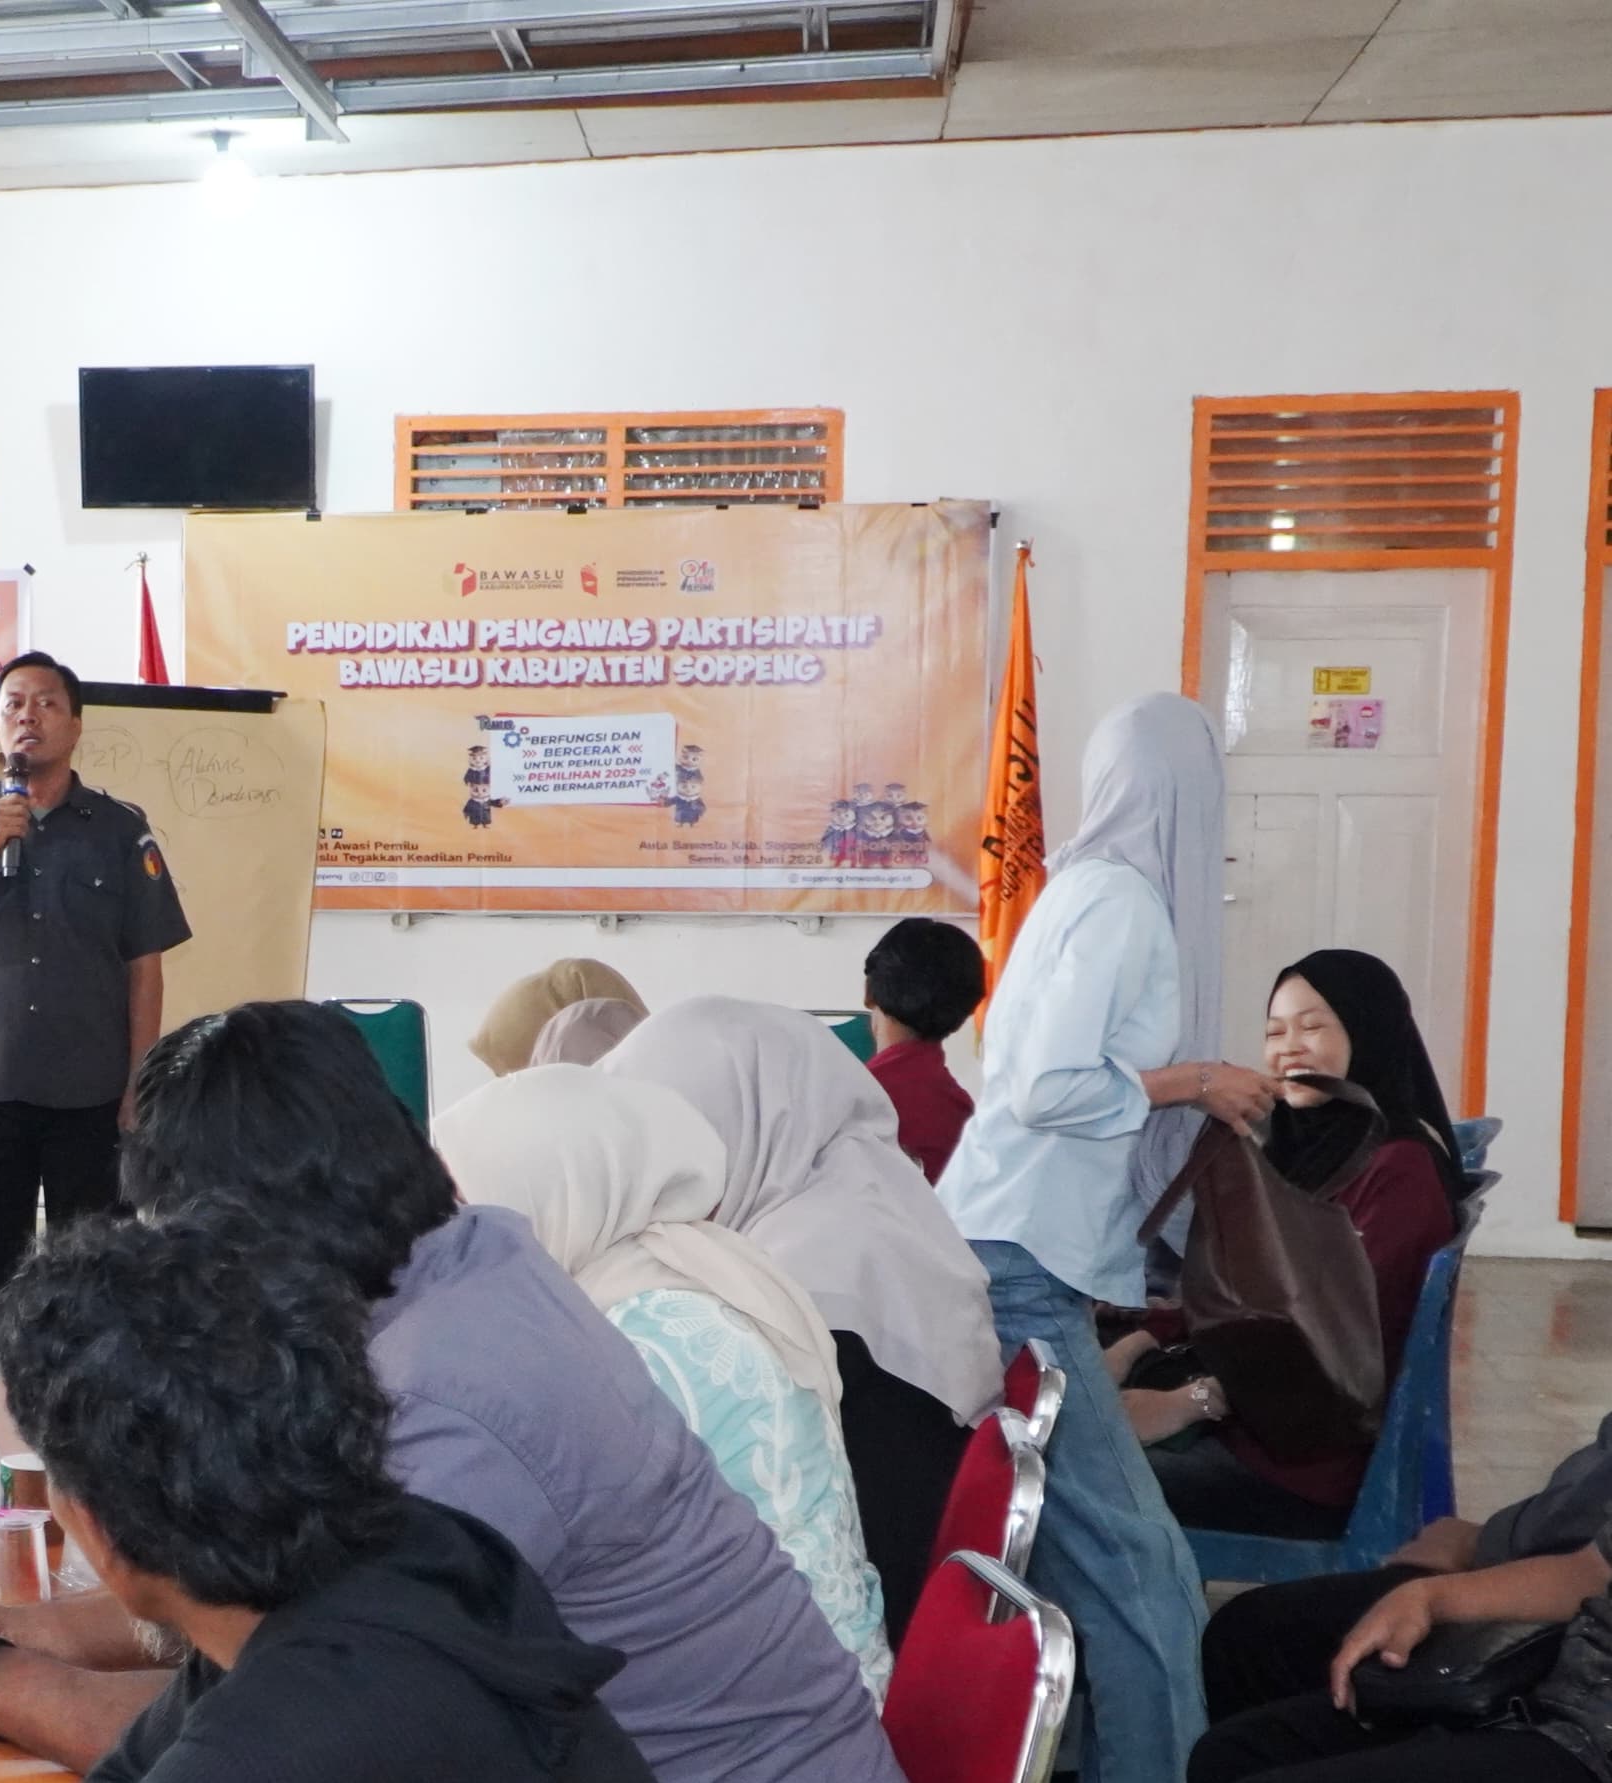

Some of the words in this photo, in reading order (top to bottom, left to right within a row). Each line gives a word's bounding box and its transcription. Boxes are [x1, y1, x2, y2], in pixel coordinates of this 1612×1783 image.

[479, 570, 564, 581] BAWASLU
[287, 619, 476, 654] PENDIDIKAN
[477, 618, 657, 652] PENGAWAS
[659, 615, 883, 650] PARTISIPATIF
[339, 656, 485, 689] BAWASLU
[486, 654, 670, 688] KABUPATEN
[673, 653, 827, 687] SOPPENG
[611, 731, 642, 742] DAN
[543, 745, 622, 758] BERGERAK
[524, 759, 565, 771] UNTUK
[567, 757, 613, 769] PEMILU
[615, 756, 642, 767] DAN
[528, 769, 602, 783] PEMILIHAN
[605, 767, 638, 780] 2029
[517, 782, 550, 794] YANG
[333, 840, 371, 851] Awasi
[374, 840, 419, 851] Pemilu
[343, 852, 403, 865] Tegakkan
[407, 852, 463, 863] Keadilan
[467, 852, 513, 863] Pemilu
